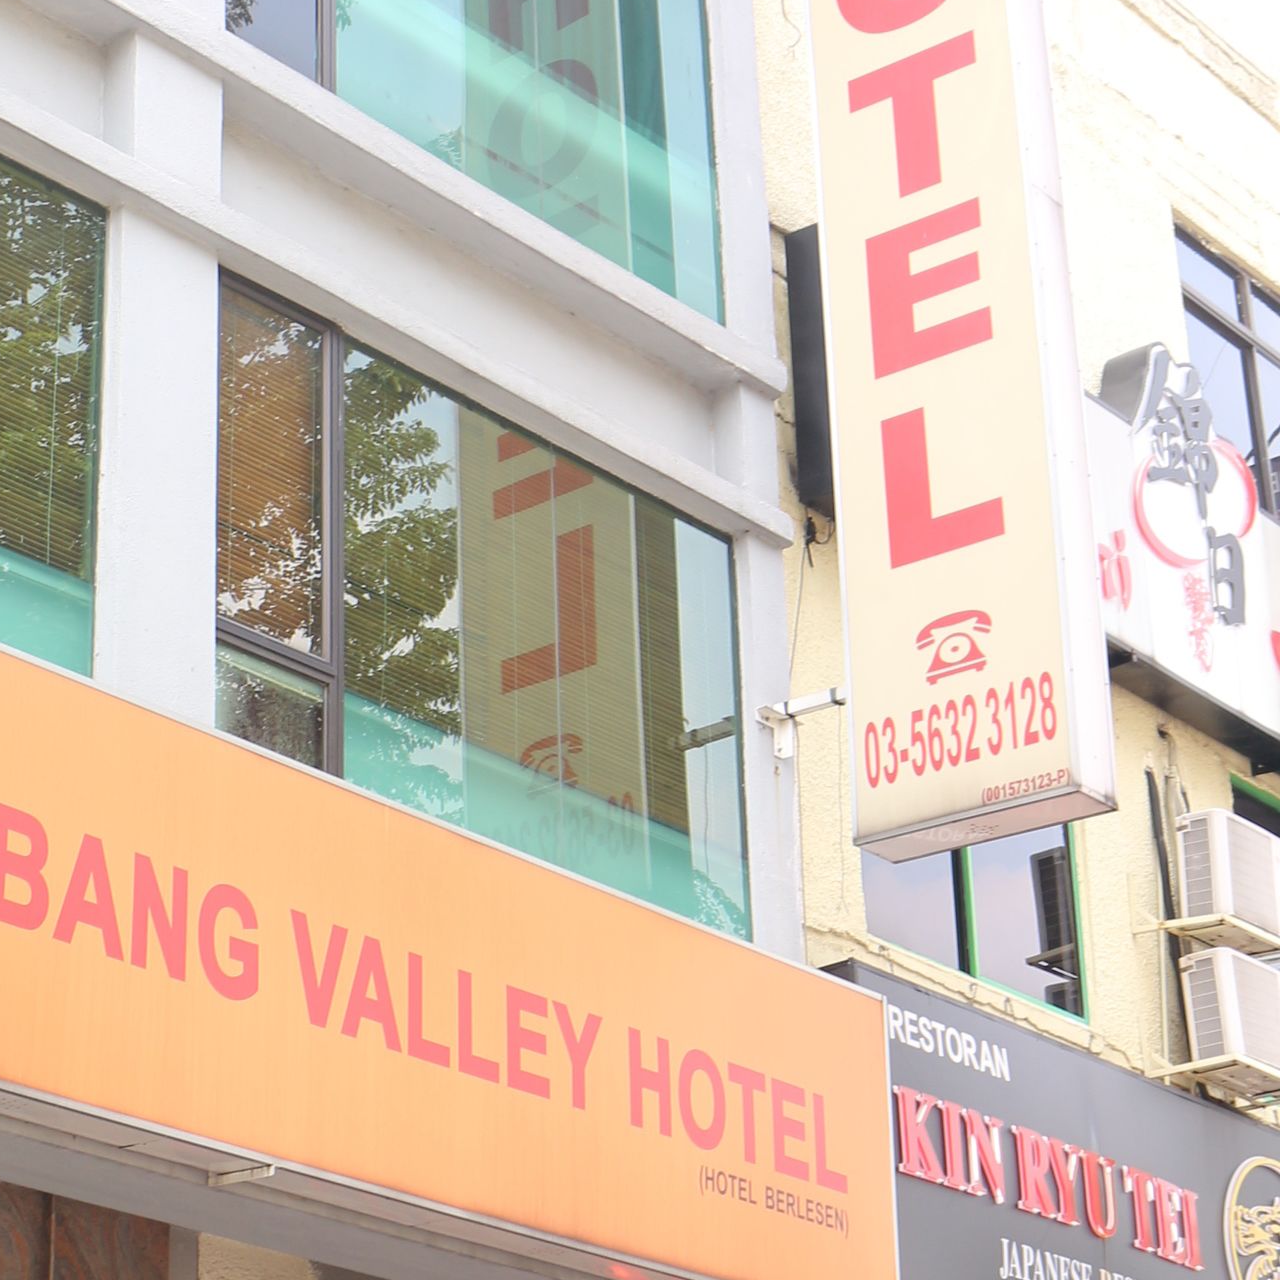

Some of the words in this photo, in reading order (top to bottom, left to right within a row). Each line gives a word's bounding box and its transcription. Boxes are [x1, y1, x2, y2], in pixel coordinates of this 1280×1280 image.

[864, 694, 981, 789] 03-5632
[984, 671, 1057, 756] 3128
[981, 767, 1072, 806] (001573123-P)
[290, 908, 603, 1111] VALLEY
[627, 1025, 849, 1195] HOTEL
[887, 1003, 1011, 1082] RESTORAN
[699, 1165, 758, 1205] (HOTEL
[765, 1185, 850, 1240] BERLESEN)
[892, 1085, 1007, 1205] KIN
[1011, 1124, 1117, 1239] RYU
[1121, 1164, 1206, 1271] TEI
